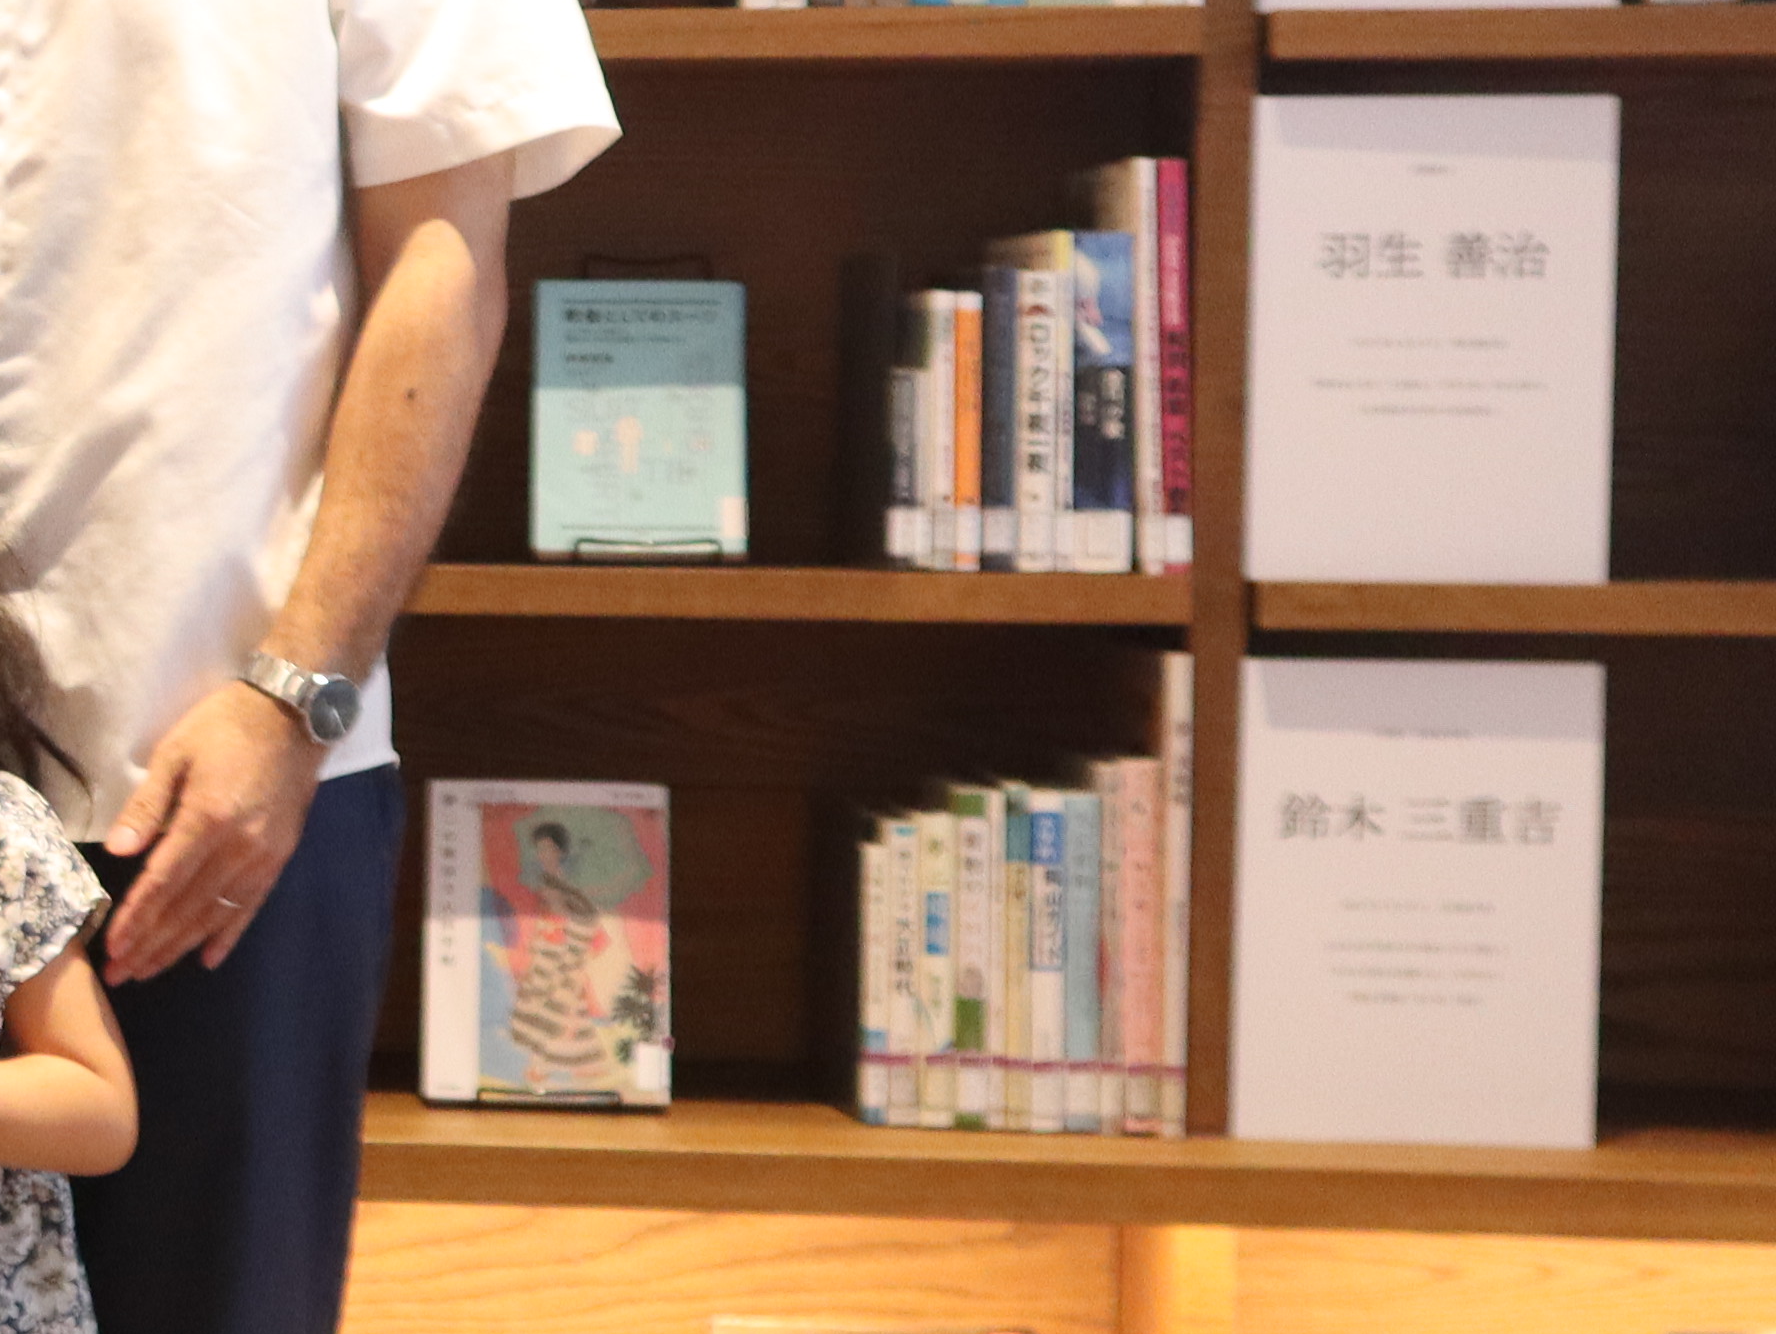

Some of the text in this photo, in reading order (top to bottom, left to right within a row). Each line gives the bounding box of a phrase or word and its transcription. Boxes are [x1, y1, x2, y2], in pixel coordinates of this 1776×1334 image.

[1319, 231, 1551, 281] 羽生 善治
[1278, 789, 1565, 847] 鈴木 三重吉
